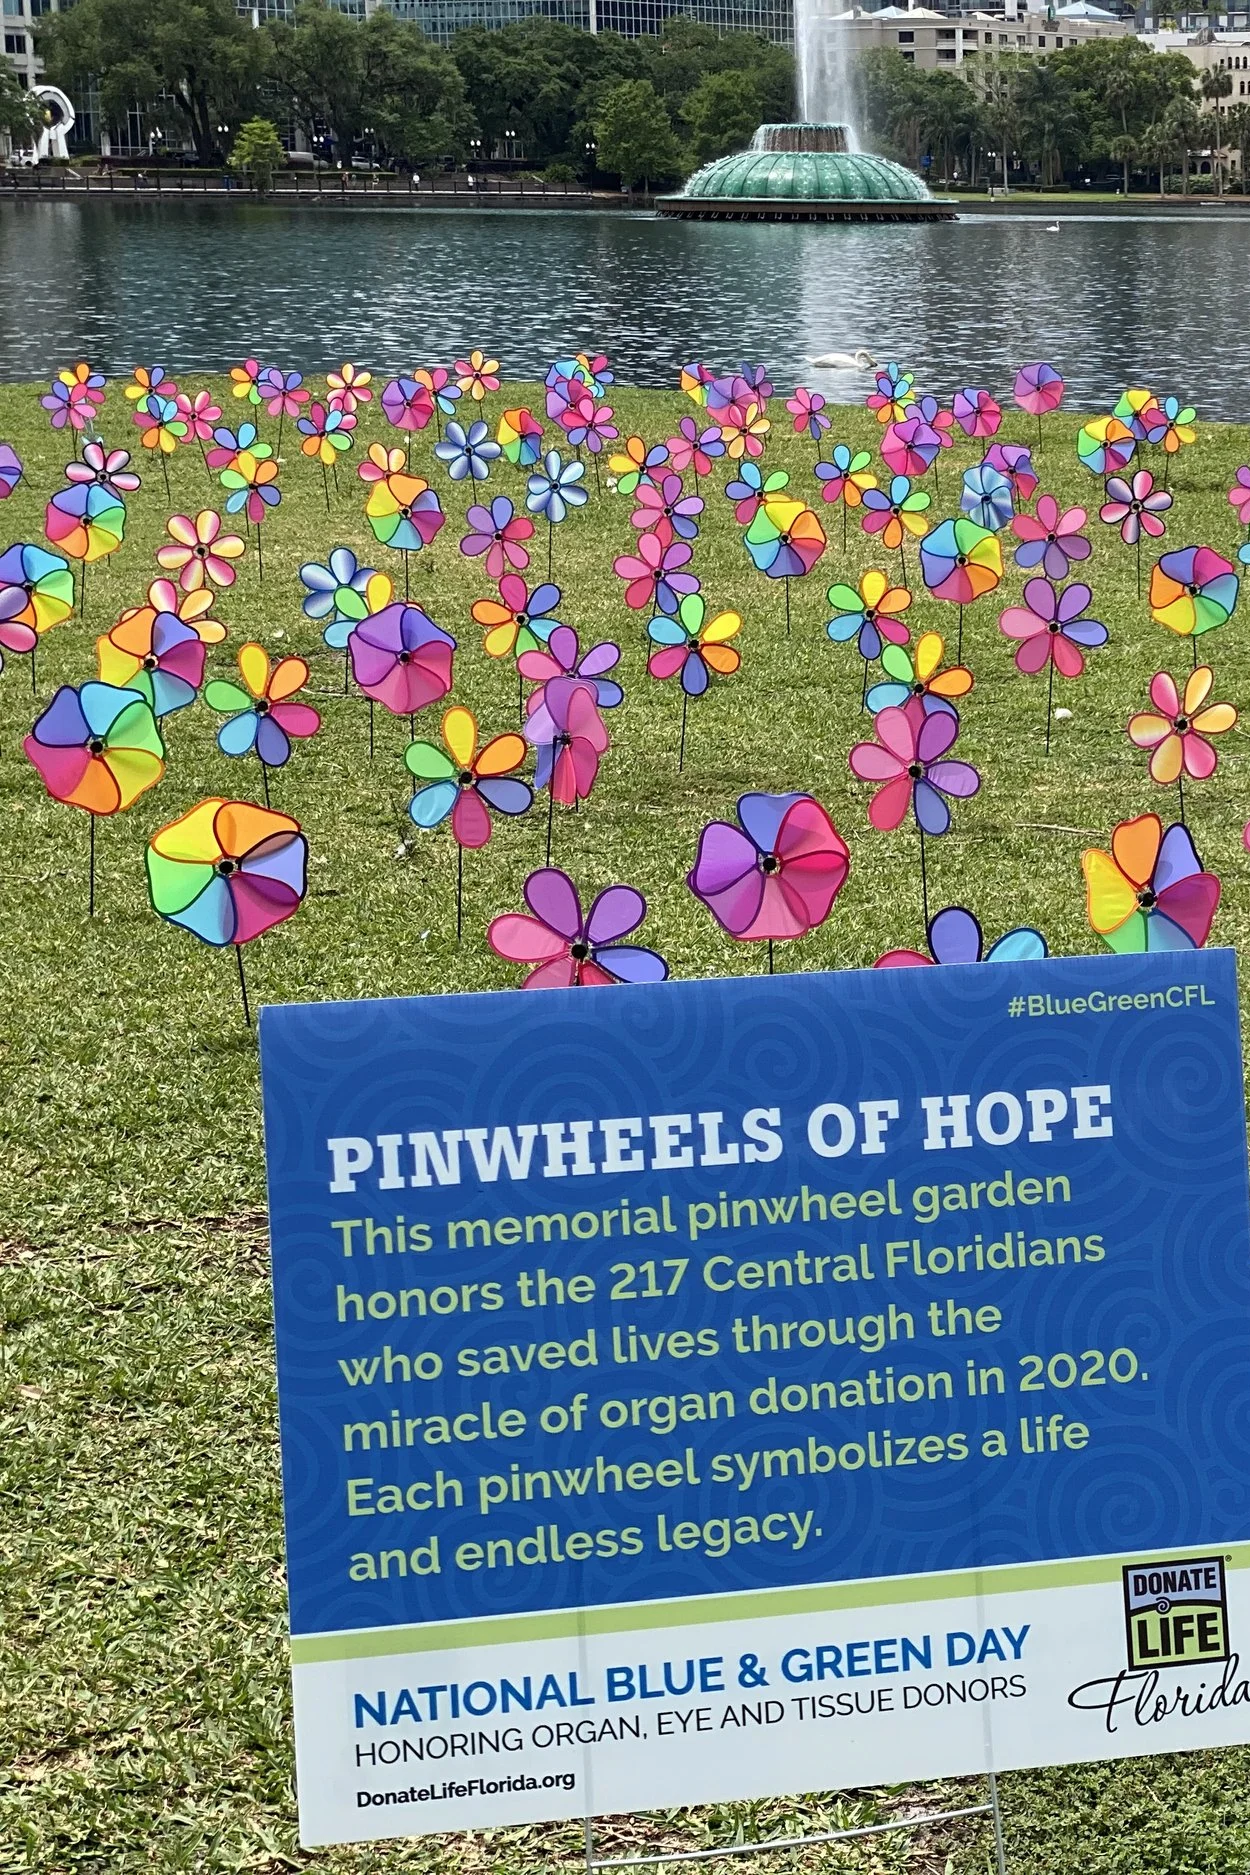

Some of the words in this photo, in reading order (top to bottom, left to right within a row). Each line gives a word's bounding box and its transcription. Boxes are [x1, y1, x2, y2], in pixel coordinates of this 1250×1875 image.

[1009, 985, 1214, 1016] #BlueGreenCFL
[328, 1108, 782, 1192] PINWHEELS
[808, 1100, 899, 1157] OF
[922, 1085, 1112, 1149] HOPE
[331, 1216, 432, 1256] This
[448, 1196, 677, 1248] memorial
[689, 1179, 902, 1240] pinwheel
[913, 1170, 1070, 1223] garden
[337, 1283, 504, 1322] honors
[517, 1269, 595, 1307] the
[611, 1259, 688, 1300] 217
[704, 1244, 874, 1291] Central
[886, 1232, 1104, 1277] Floridians
[339, 1346, 442, 1386] who
[458, 1329, 598, 1376] saved
[613, 1326, 719, 1363] lives
[732, 1304, 914, 1353] through
[928, 1300, 1001, 1336] the
[344, 1402, 526, 1451] miracle
[540, 1393, 588, 1433] of
[600, 1391, 734, 1434] organ
[749, 1367, 952, 1414] donation
[968, 1360, 1004, 1396] in
[1020, 1348, 1147, 1391] 2020.
[347, 1471, 463, 1516] Each
[480, 1448, 700, 1514] pinwheel
[712, 1430, 968, 1491] symbolizes
[982, 1430, 1007, 1457] a
[1021, 1414, 1089, 1453] life
[349, 1536, 440, 1581] and
[455, 1525, 643, 1570] endless
[658, 1511, 821, 1557] legacy.
[1133, 1567, 1217, 1597] DONATE
[355, 1672, 595, 1728] NATIONAL
[607, 1657, 724, 1702] BLUE
[738, 1654, 770, 1688] &
[781, 1635, 931, 1683] GREEN
[947, 1625, 1030, 1666] DAY
[1137, 1612, 1220, 1659] LIFE
[356, 1728, 522, 1766] HONORING
[532, 1716, 647, 1748] ORGAN,
[658, 1708, 712, 1735] EYE
[721, 1701, 784, 1728] AND
[791, 1689, 894, 1720] TISSUE
[904, 1675, 1026, 1709] DONORS
[357, 1774, 575, 1807] DonateLifeFlorida.org
